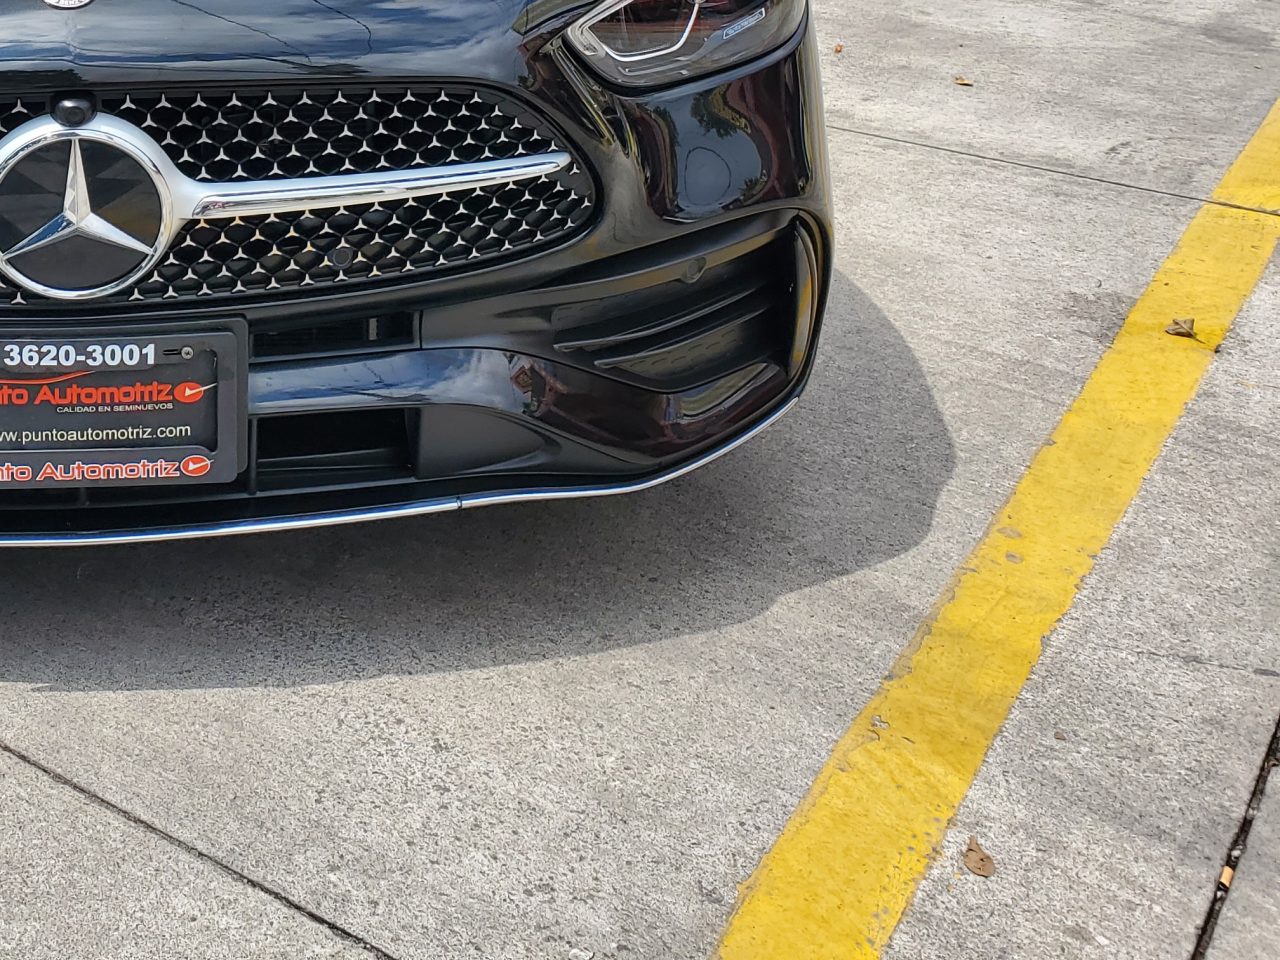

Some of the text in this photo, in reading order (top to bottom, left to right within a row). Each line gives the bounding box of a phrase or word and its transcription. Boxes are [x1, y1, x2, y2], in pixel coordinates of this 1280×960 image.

[3, 343, 156, 367] 3620-3001
[33, 380, 174, 404] Automotriz
[56, 402, 174, 414] CALIDAD EN SEMINUEVOS
[36, 458, 180, 482] Automotriz
